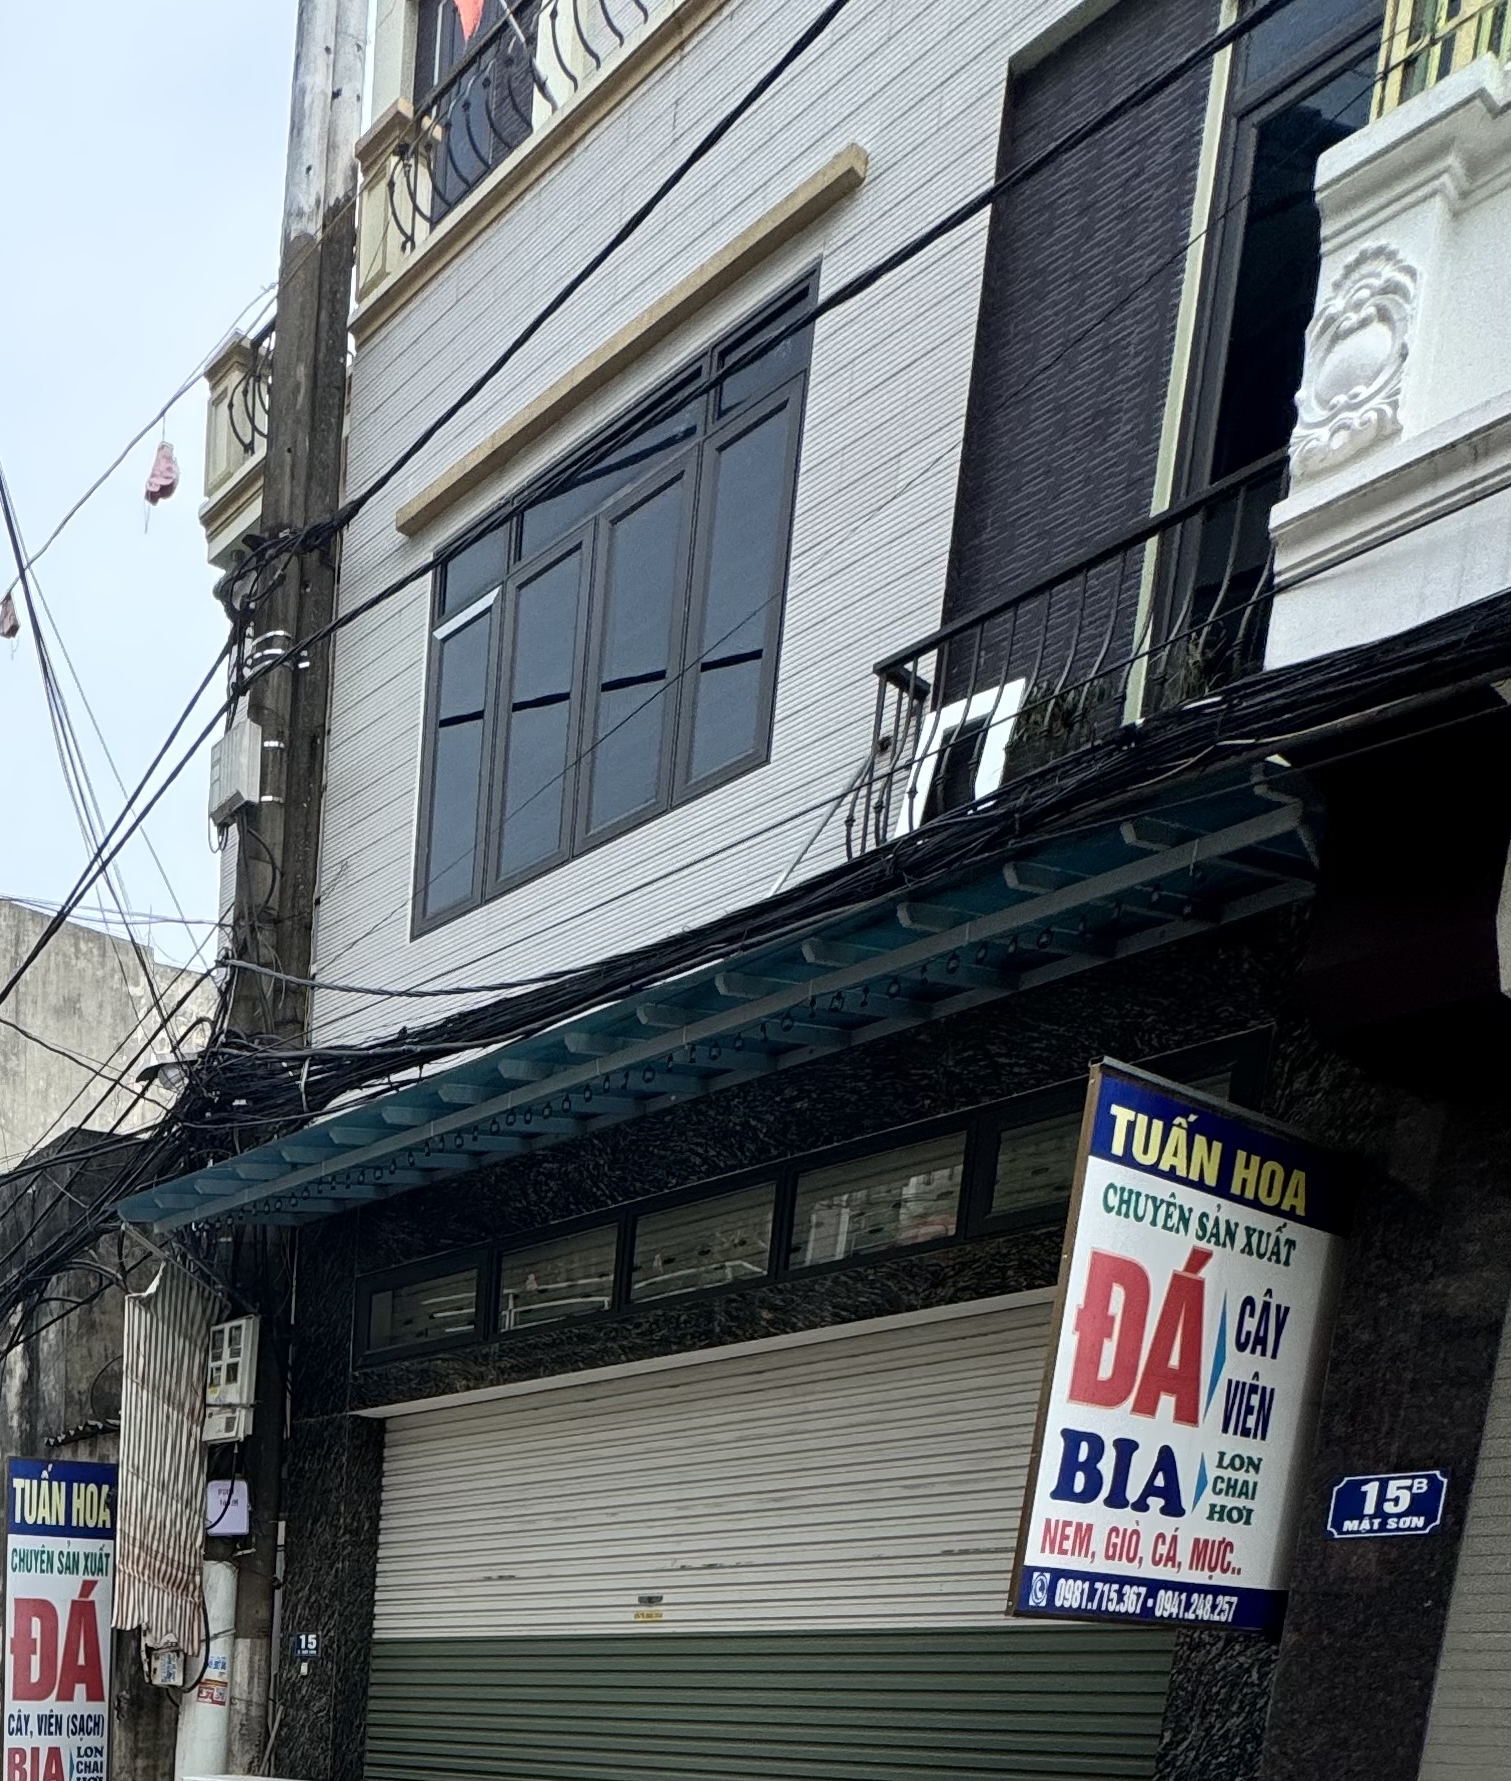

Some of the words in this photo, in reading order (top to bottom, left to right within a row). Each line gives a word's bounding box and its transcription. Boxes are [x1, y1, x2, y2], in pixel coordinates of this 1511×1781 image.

[1110, 1104, 1222, 1187] TUẤN
[1230, 1150, 1306, 1216] HOA
[1103, 1183, 1191, 1236] CHUYÊN
[1195, 1204, 1239, 1251] SẢN
[1241, 1222, 1296, 1267] XUẤT
[1067, 1244, 1213, 1427] ĐÁ
[1235, 1288, 1290, 1359] CÂY
[1221, 1371, 1275, 1441] VIÊN
[1049, 1428, 1185, 1517] BIA
[1215, 1451, 1263, 1475] LON
[12, 1463, 66, 1526] TUẤN
[71, 1483, 111, 1528] HOA
[1211, 1475, 1258, 1500] CHAI
[1206, 1503, 1254, 1525] HƠI
[1343, 1516, 1382, 1533] MẬT
[1386, 1516, 1425, 1529] SƠN
[11, 1544, 54, 1575] CHUYÊN
[57, 1540, 79, 1575] SẢN
[82, 1544, 110, 1577] XUẤT
[1040, 1518, 1096, 1563] NEM,
[1103, 1520, 1143, 1569] GIÒ,
[1151, 1527, 1182, 1573] CÁ,
[1188, 1536, 1241, 1580] MỰC..
[1054, 1578, 1147, 1614] 0981.715.367
[1155, 1589, 1238, 1622] 0941.248.257
[10, 1580, 105, 1702] ĐÁ
[299, 1634, 317, 1649] 15
[8, 1709, 33, 1739] CÂY,
[37, 1709, 63, 1736] VIÊN
[67, 1713, 105, 1741] (SẠCH)
[76, 1746, 104, 1758] LON
[76, 1760, 103, 1774] CHAI
